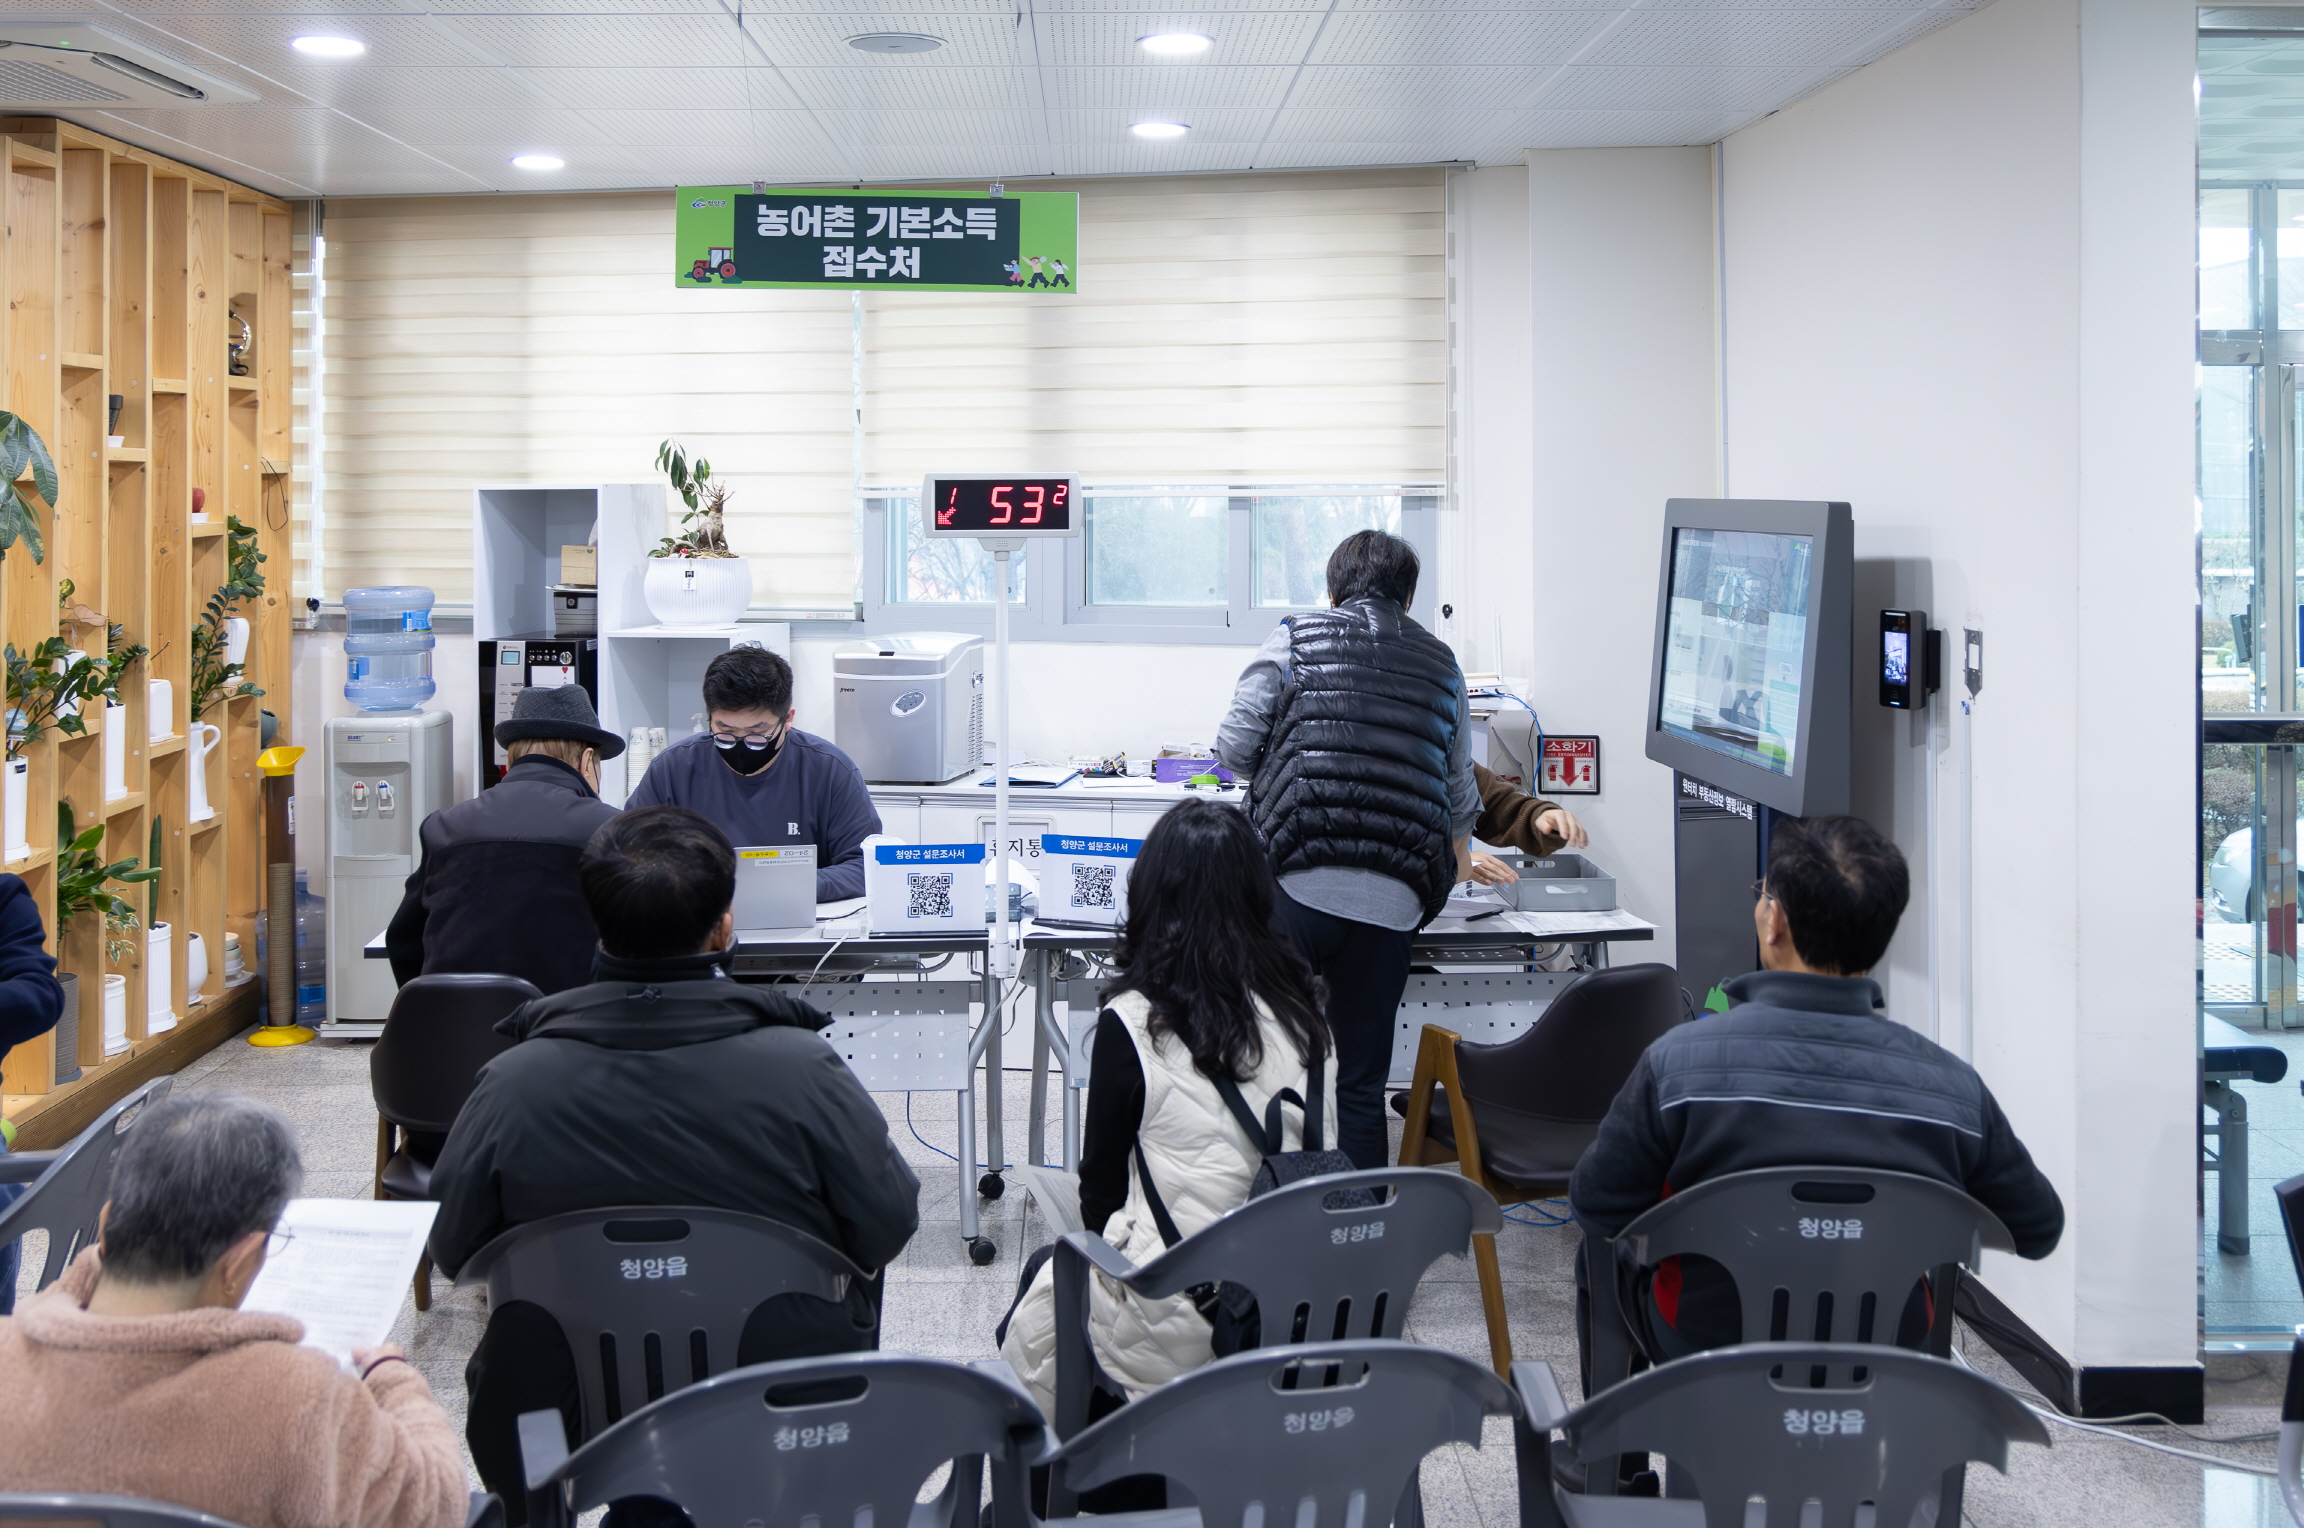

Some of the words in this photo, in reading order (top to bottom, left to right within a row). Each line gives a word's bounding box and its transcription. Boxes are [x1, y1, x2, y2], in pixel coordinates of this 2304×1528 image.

[757, 204, 855, 238] 농어촌
[866, 206, 997, 240] 기본소득
[823, 246, 921, 279] 접수처
[989, 486, 1045, 524] 53
[1052, 485, 1068, 505] 2
[1546, 741, 1592, 753] 소화기
[1682, 778, 1698, 798] 원터치
[1698, 784, 1724, 807] 부동산정보
[1725, 795, 1753, 820] 열람시스템
[895, 849, 921, 860] 청양군
[922, 848, 965, 859] 설문조사서
[1060, 839, 1086, 850] 청양군
[1087, 841, 1128, 853] 설문조사서
[1330, 1221, 1386, 1245] 청양읍
[1798, 1217, 1864, 1239] 청양읍
[620, 1256, 688, 1279] 청양읍
[1783, 1408, 1866, 1435] 청양읍
[773, 1421, 851, 1450] 청양읍
